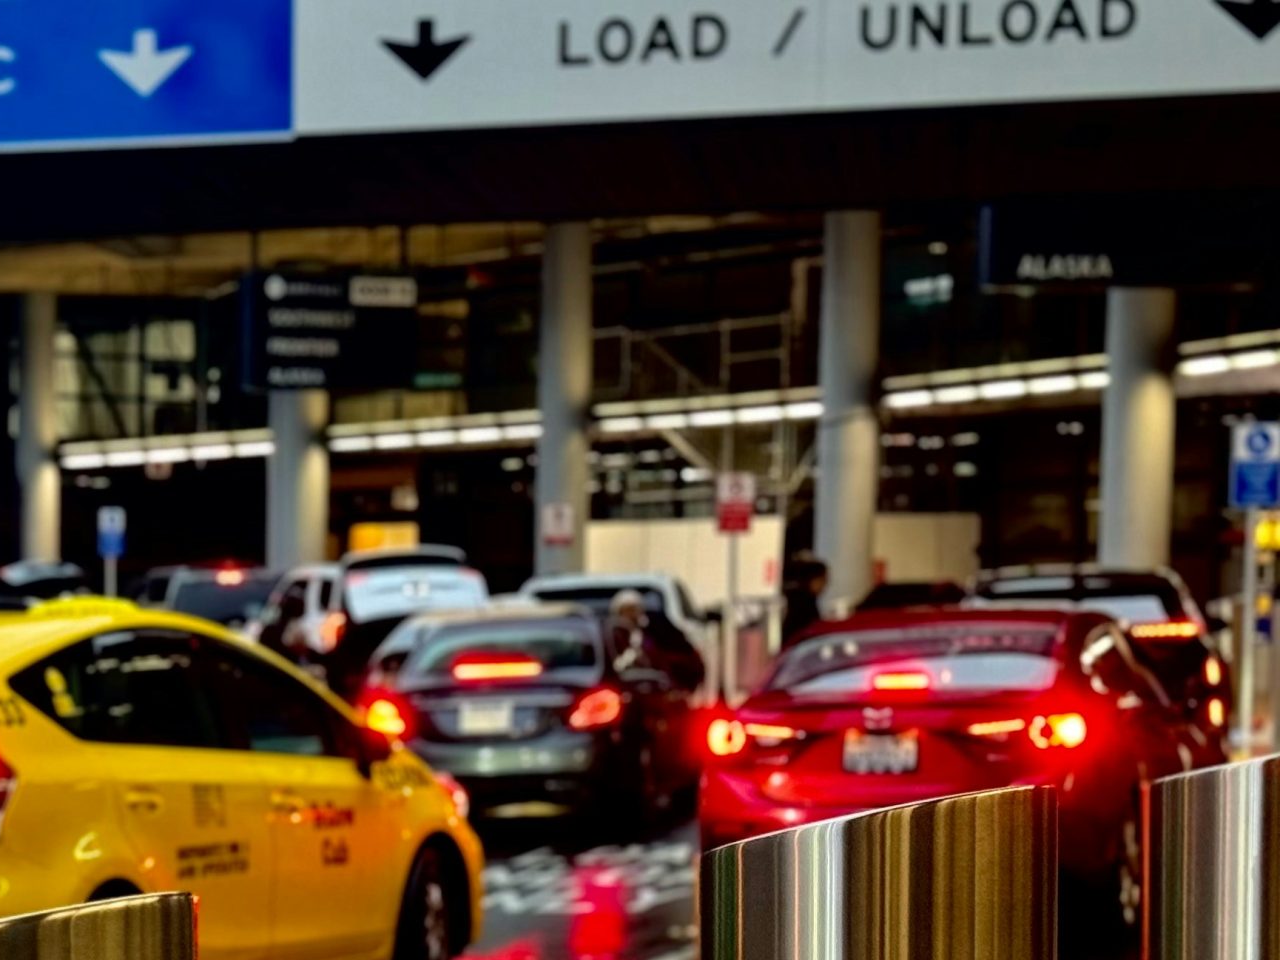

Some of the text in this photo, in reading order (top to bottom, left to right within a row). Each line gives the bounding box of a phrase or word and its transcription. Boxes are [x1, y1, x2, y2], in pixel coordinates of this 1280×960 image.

[558, 0, 1137, 66] LOAD / UNLOAD
[1017, 253, 1114, 280] ALASKA
